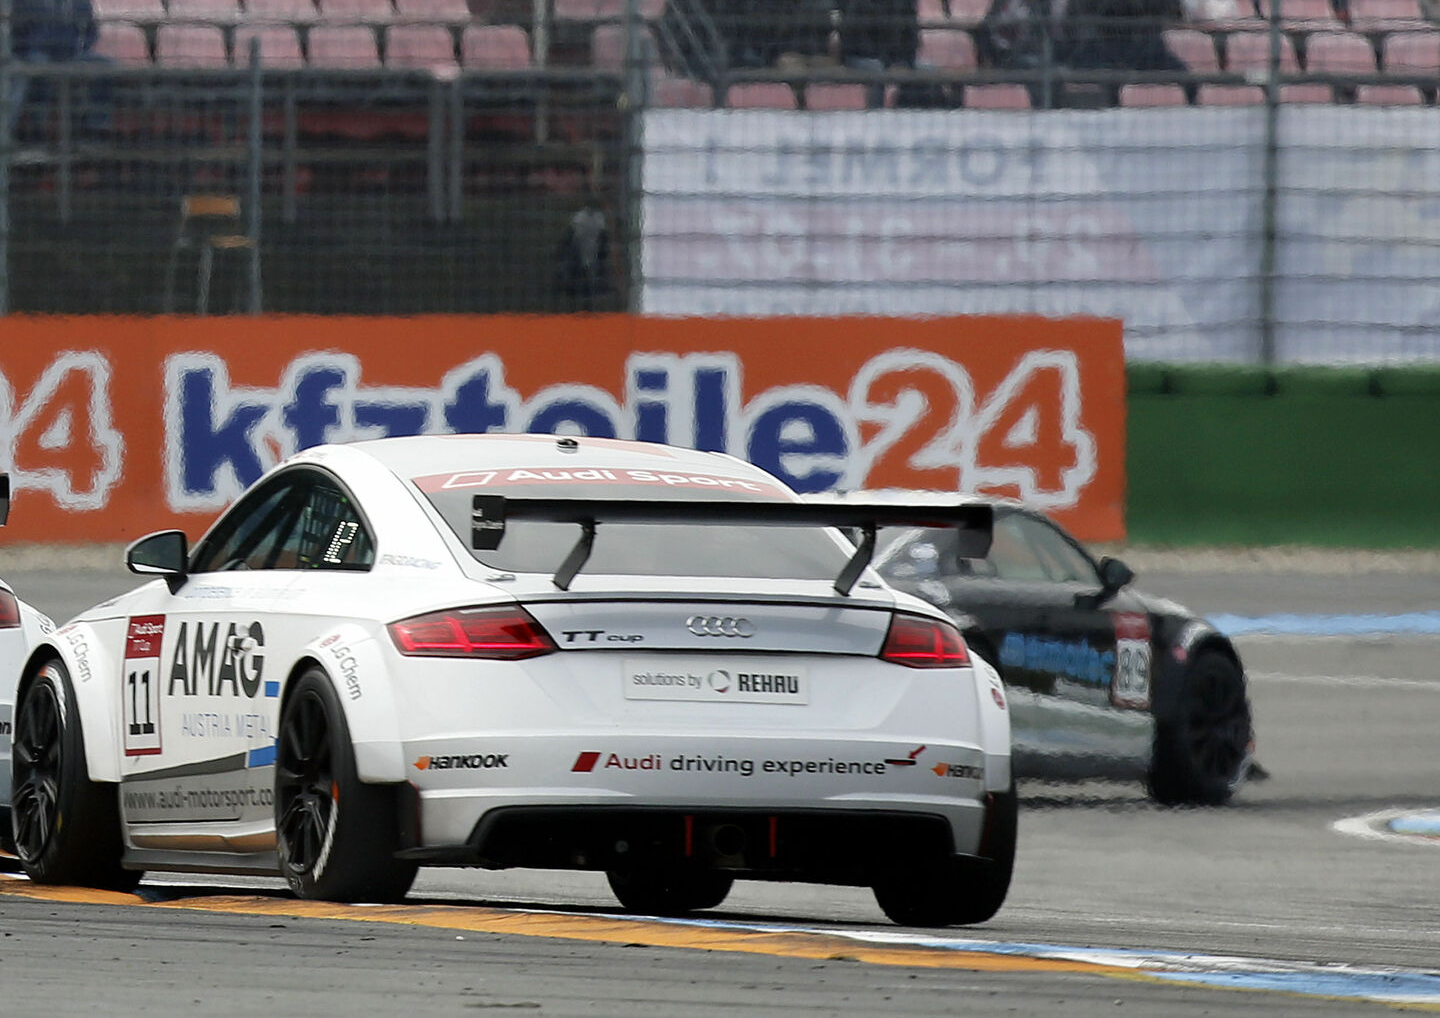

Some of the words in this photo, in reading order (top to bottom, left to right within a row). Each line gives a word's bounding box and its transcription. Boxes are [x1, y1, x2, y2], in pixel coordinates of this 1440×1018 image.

[506, 468, 617, 483] Audi
[625, 468, 764, 493] Sport
[561, 630, 605, 643] TT
[606, 633, 645, 644] cup
[168, 620, 266, 699] AMAG
[340, 656, 363, 701] Chem
[632, 671, 686, 686] solutions
[687, 672, 703, 690] by
[737, 672, 800, 694] REHAU
[128, 670, 155, 736] 11
[182, 712, 233, 738] AUSTRIA
[604, 751, 662, 771] Audi
[670, 752, 755, 778] driving
[761, 755, 887, 779] experience
[123, 784, 275, 815] www.audi-motorsport.co
